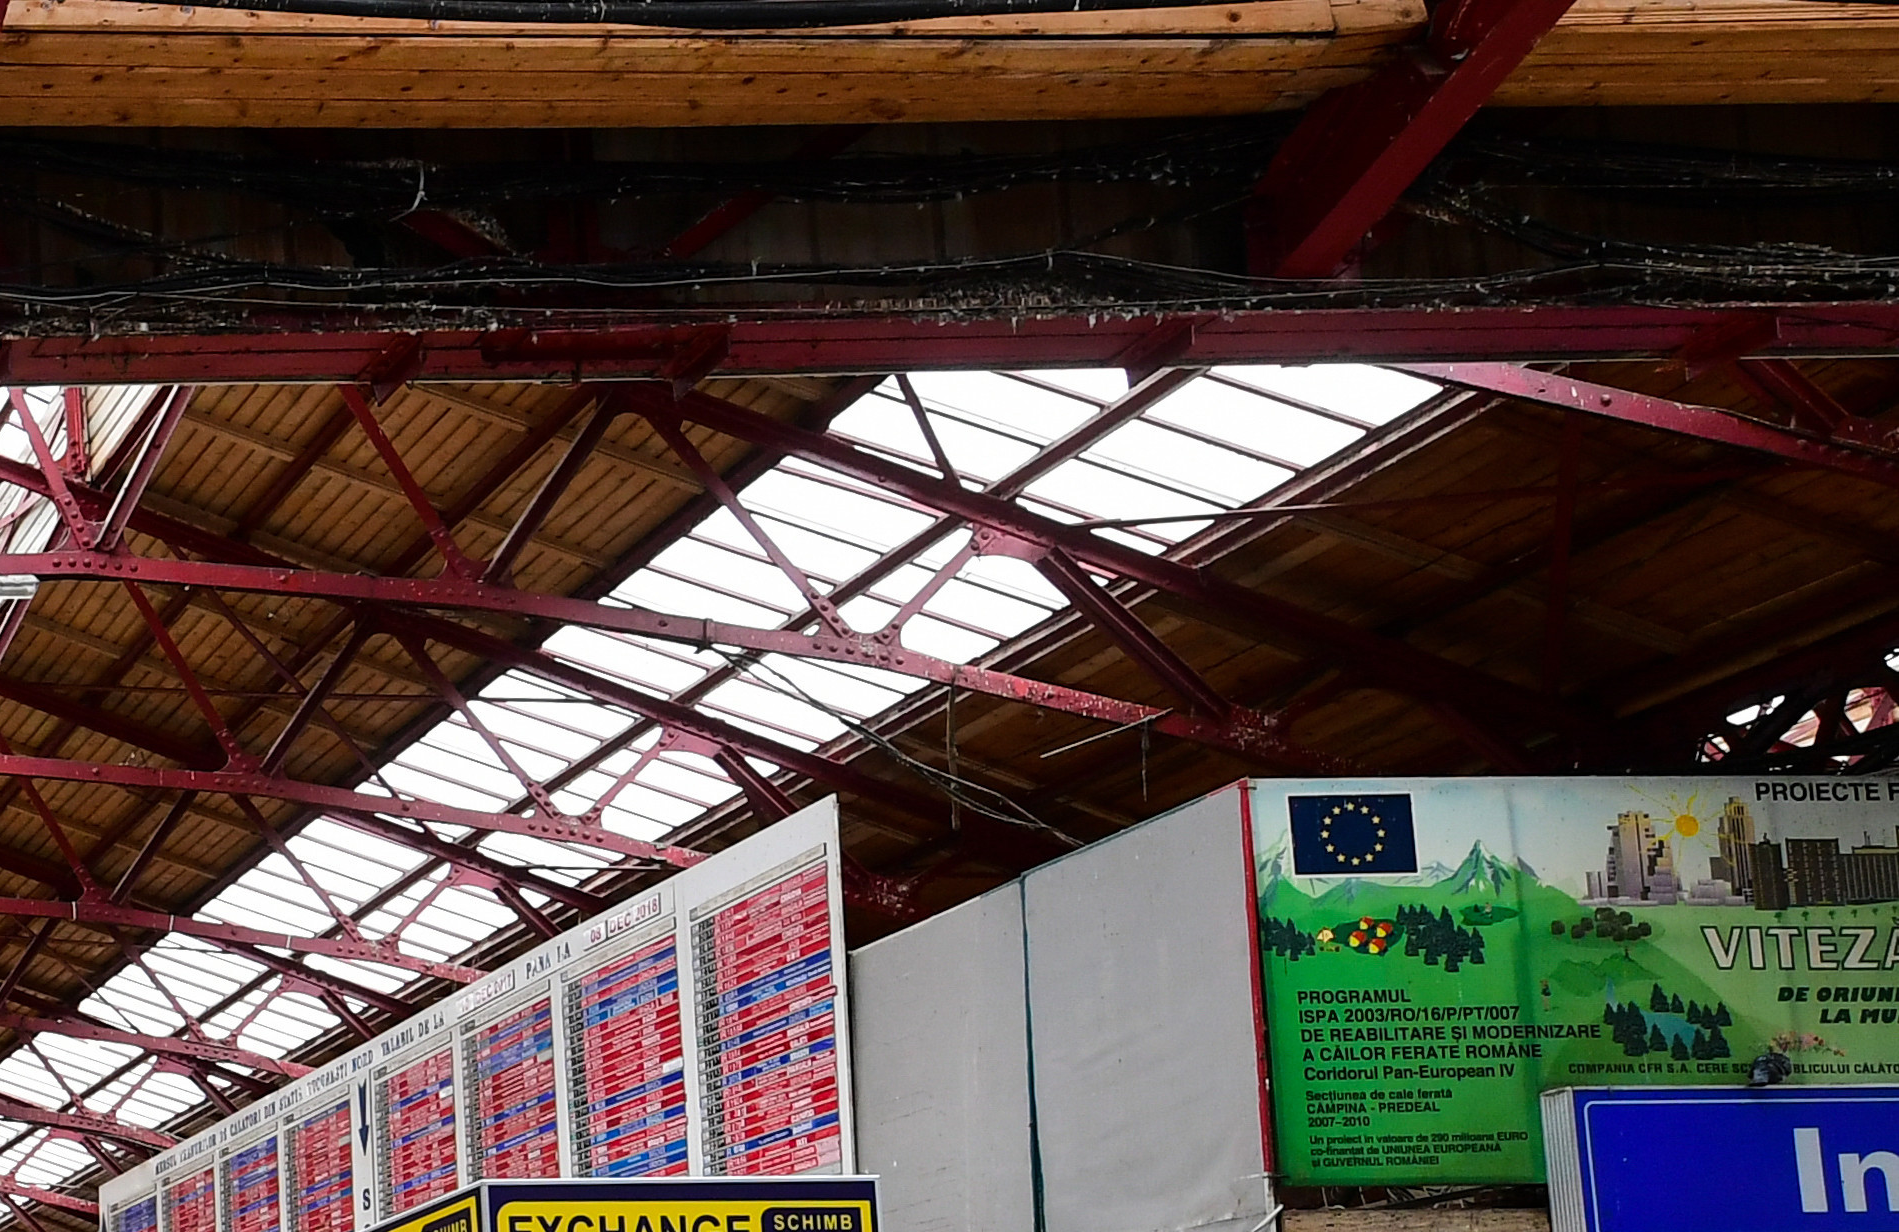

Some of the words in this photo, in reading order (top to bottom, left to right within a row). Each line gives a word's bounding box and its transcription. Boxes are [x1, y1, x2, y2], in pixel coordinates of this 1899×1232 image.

[1755, 782, 1881, 802] PROIECTE
[556, 941, 572, 965] LA
[609, 911, 633, 935] DEC
[634, 897, 659, 922] 2018
[1297, 989, 1411, 1005] PROGRAMUL
[1777, 986, 1809, 1002] DE
[1299, 1009, 1339, 1024] ISPA
[1344, 1005, 1520, 1023] 2003/RO/16/P/PT/007
[1820, 1008, 1851, 1024] LA
[1301, 1028, 1324, 1042] DE
[1330, 1026, 1445, 1041] REABILITARE
[1472, 1024, 1601, 1040] MODERNIZARE
[1302, 1049, 1315, 1062] A
[1319, 1044, 1386, 1061] CĂILOR
[1391, 1045, 1460, 1060] FERATE
[1465, 1041, 1542, 1059] ROMÂNE
[1304, 1066, 1378, 1082] Coridorul
[1383, 1064, 1496, 1081] Pan-European
[1500, 1063, 1516, 1078] IV
[1568, 1063, 1634, 1075] COMPANIA
[1638, 1063, 1663, 1075] CFR
[1667, 1063, 1693, 1075] S.A.
[1697, 1063, 1729, 1075] CERE
[1792, 1063, 1850, 1075] BLICULUI
[1370, 1089, 1387, 1100] de
[1388, 1089, 1414, 1100] cale
[1378, 1101, 1441, 1114] PREDEAL
[1309, 1135, 1324, 1145] Un
[1326, 1134, 1362, 1146] proiect
[1376, 1133, 1414, 1144] valoare
[1415, 1133, 1429, 1143] de
[1451, 1132, 1495, 1142] milioane
[1497, 1131, 1528, 1141] EURO
[1366, 1145, 1380, 1155] de
[1382, 1144, 1431, 1155] UNIUNEA
[1323, 1156, 1384, 1167] GUVERNUL
[773, 1213, 854, 1232] SCHIMB
